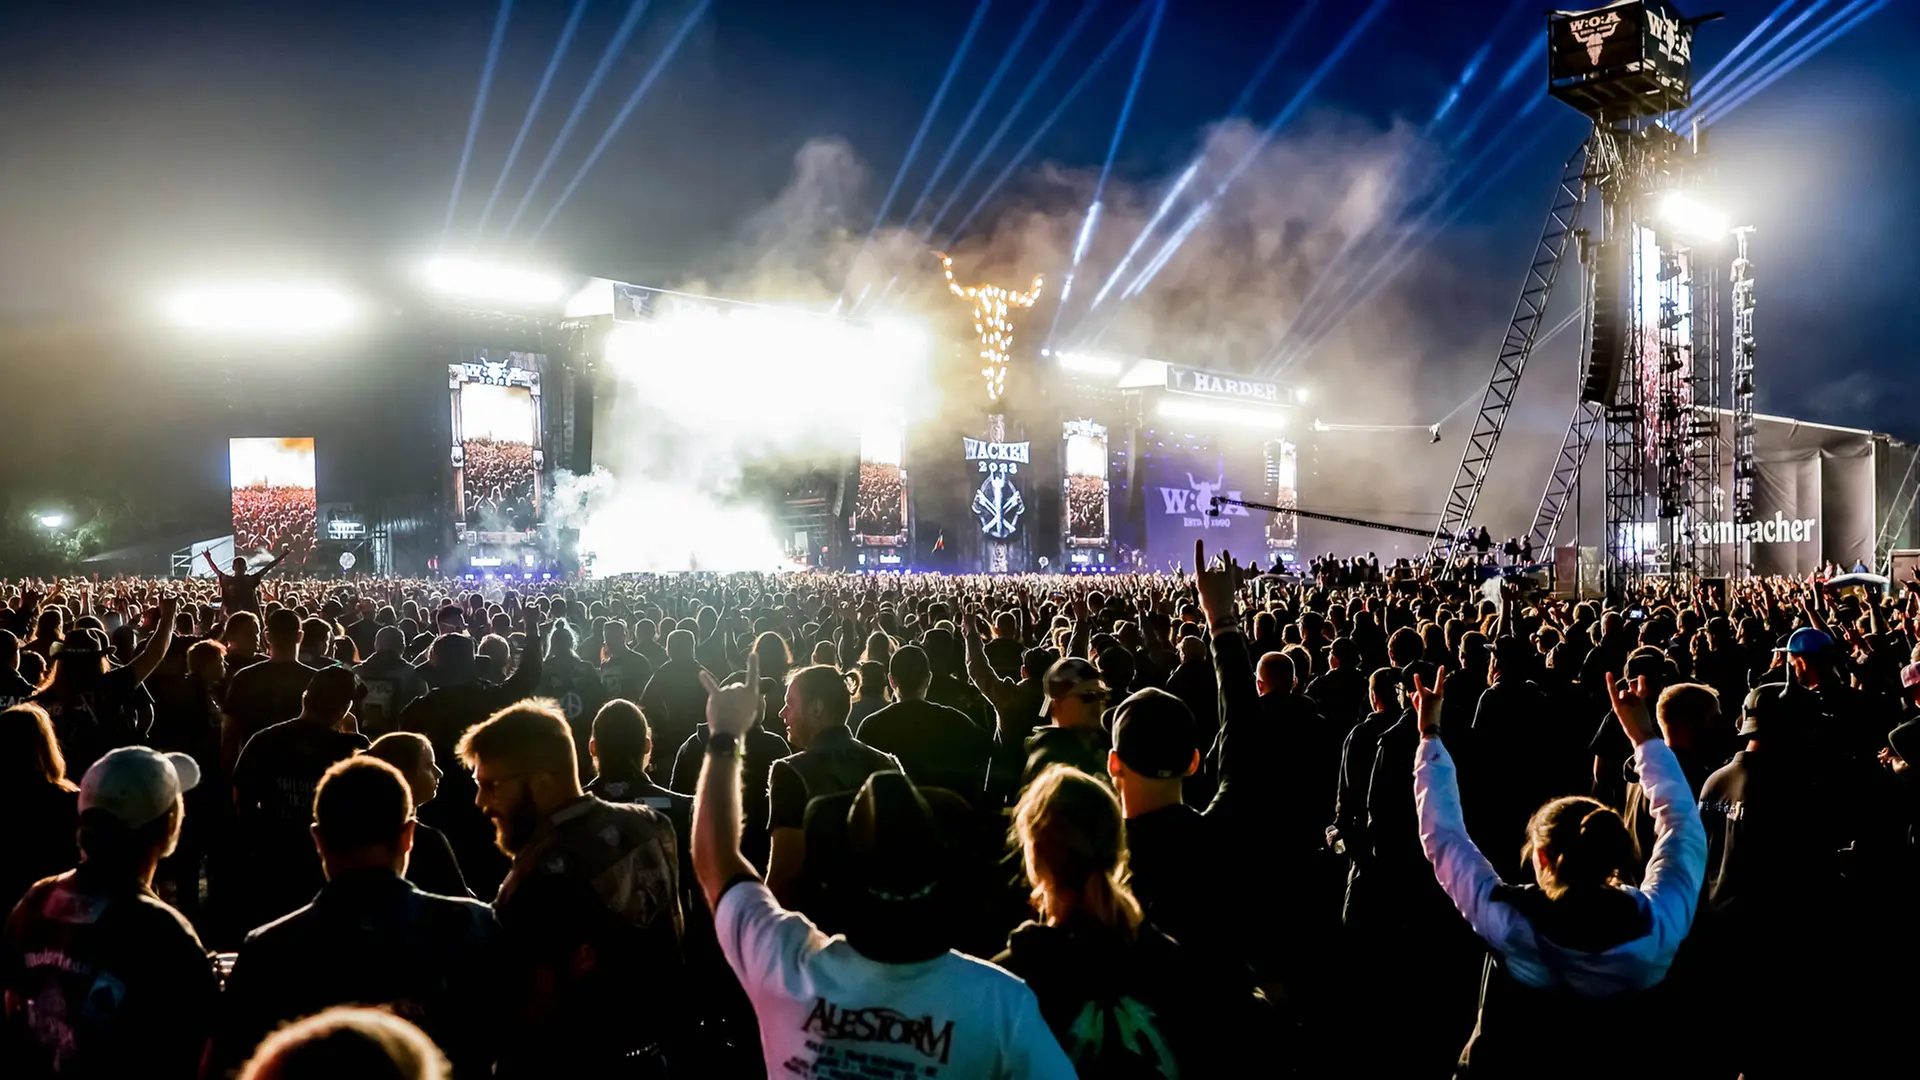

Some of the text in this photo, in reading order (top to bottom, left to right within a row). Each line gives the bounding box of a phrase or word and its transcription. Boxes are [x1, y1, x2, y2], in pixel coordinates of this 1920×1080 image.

[1569, 12, 1621, 31] W:O:A
[1192, 371, 1277, 401] HARDER
[963, 437, 1029, 463] WACKEN
[978, 461, 1017, 474] 2023
[801, 997, 955, 1064] ALESTORM
